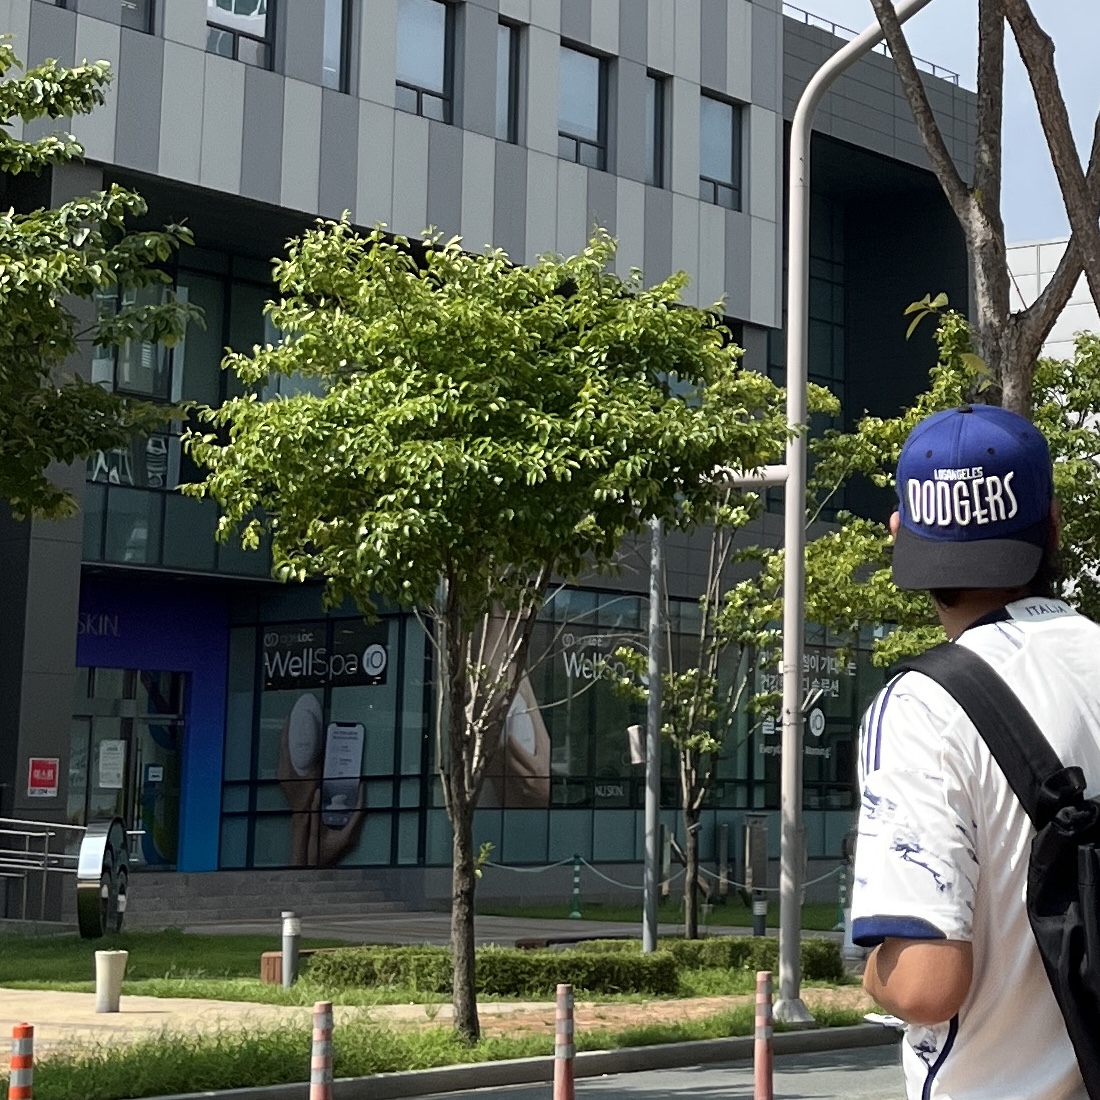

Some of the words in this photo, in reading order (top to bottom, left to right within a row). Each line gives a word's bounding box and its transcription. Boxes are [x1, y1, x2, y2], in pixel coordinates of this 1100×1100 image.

[908, 471, 1018, 526] DODGERS
[1025, 604, 1067, 617] ITALIA
[78, 612, 118, 636] SKIN
[264, 648, 358, 680] WellSpa
[820, 655, 857, 676] 기다는
